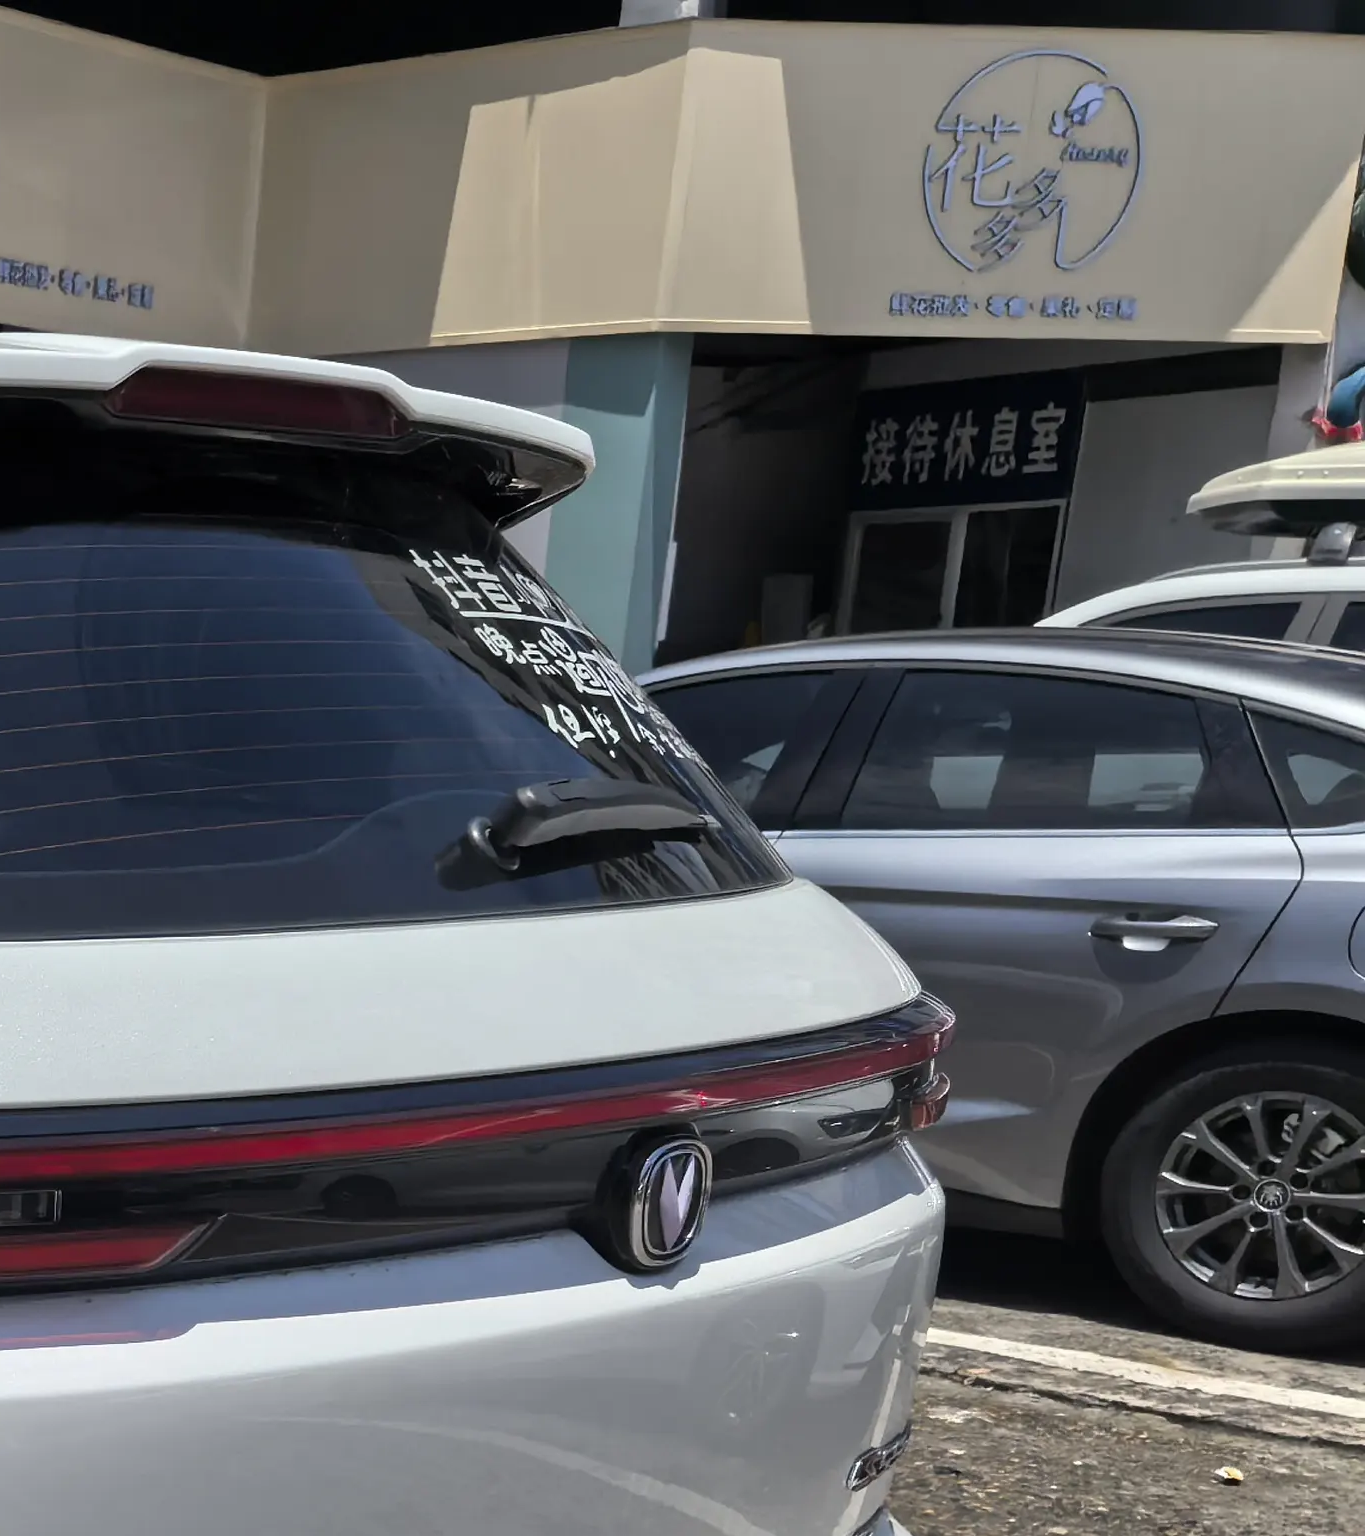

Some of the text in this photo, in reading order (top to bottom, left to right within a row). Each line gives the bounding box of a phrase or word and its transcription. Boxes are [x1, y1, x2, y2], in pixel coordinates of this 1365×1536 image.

[861, 401, 1068, 487] 接待休息室
[409, 549, 521, 614] 抖音
